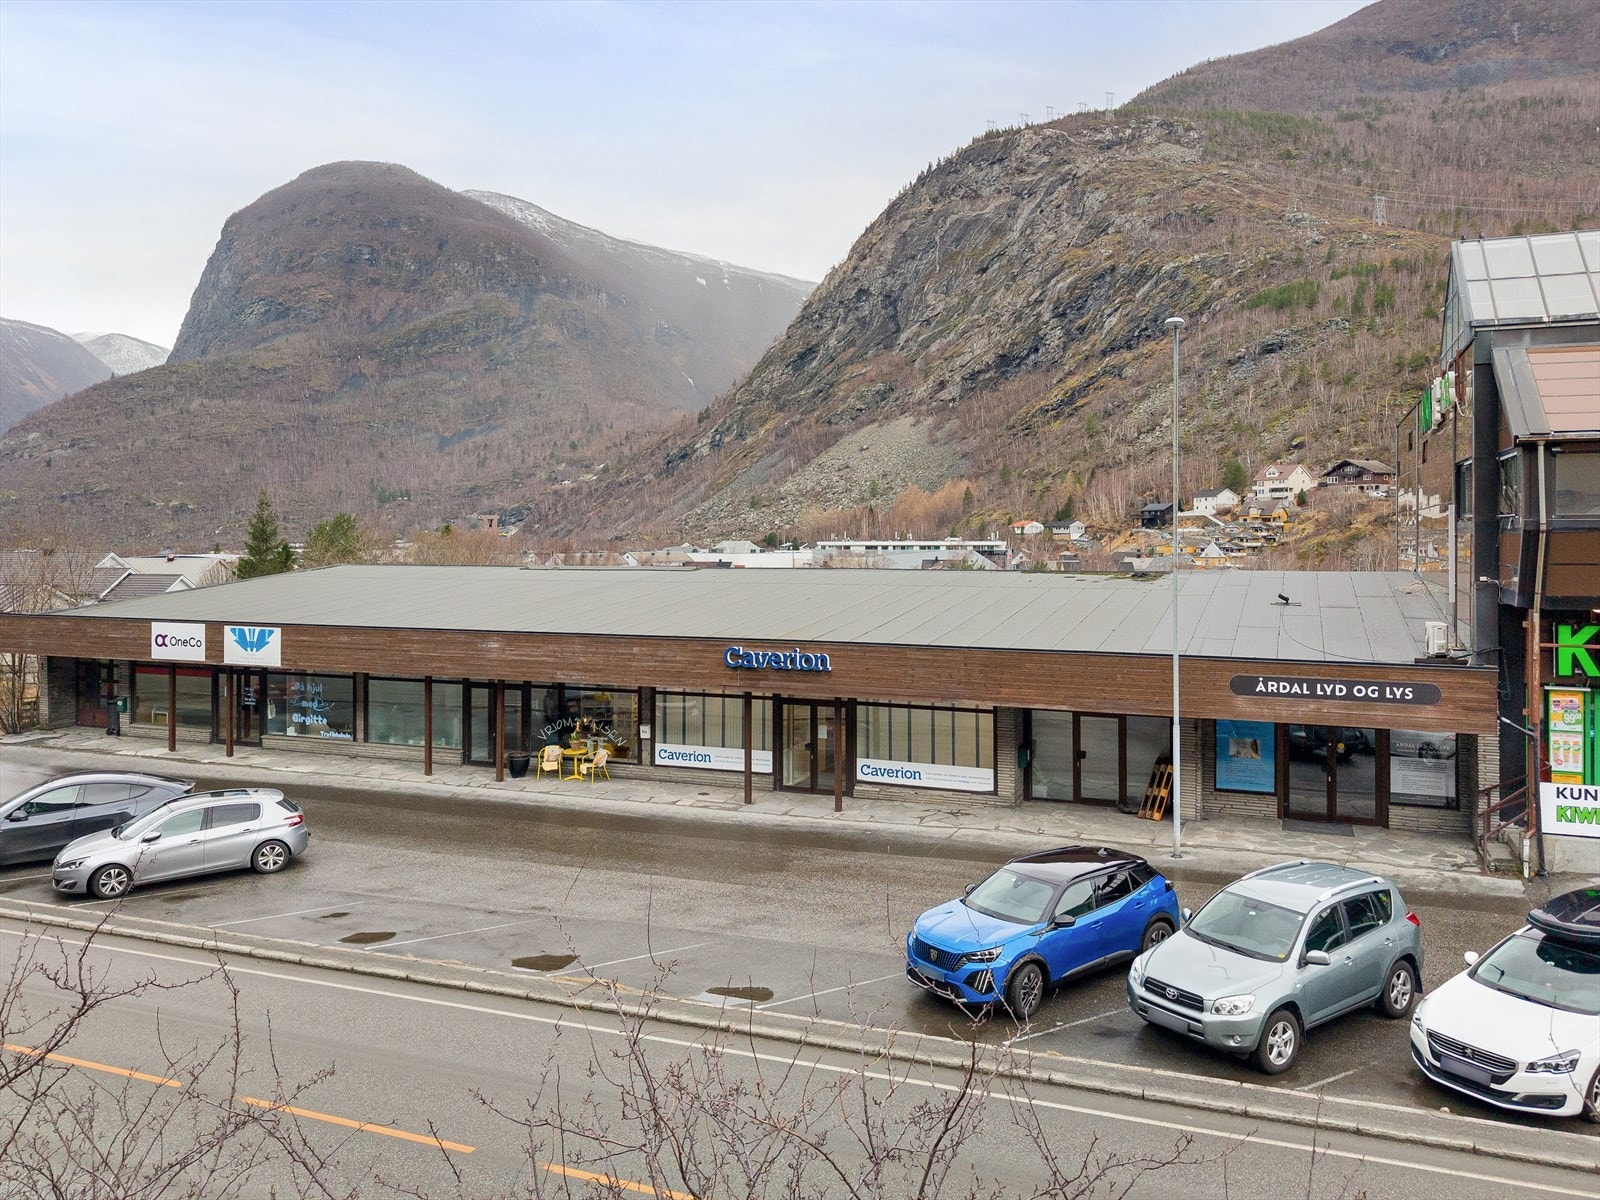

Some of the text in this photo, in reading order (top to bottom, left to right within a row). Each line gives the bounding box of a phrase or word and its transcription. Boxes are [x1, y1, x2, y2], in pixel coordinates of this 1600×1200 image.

[169, 636, 202, 648] OneCo
[1557, 624, 1600, 677] K
[724, 646, 831, 672] Caverion
[307, 683, 323, 694] hjul
[1255, 677, 1414, 700] ÅRDAL LYD OG LYS
[301, 700, 318, 708] med
[292, 713, 328, 725] Birgitte
[658, 748, 712, 763] Caverion
[860, 763, 922, 781] Caverion
